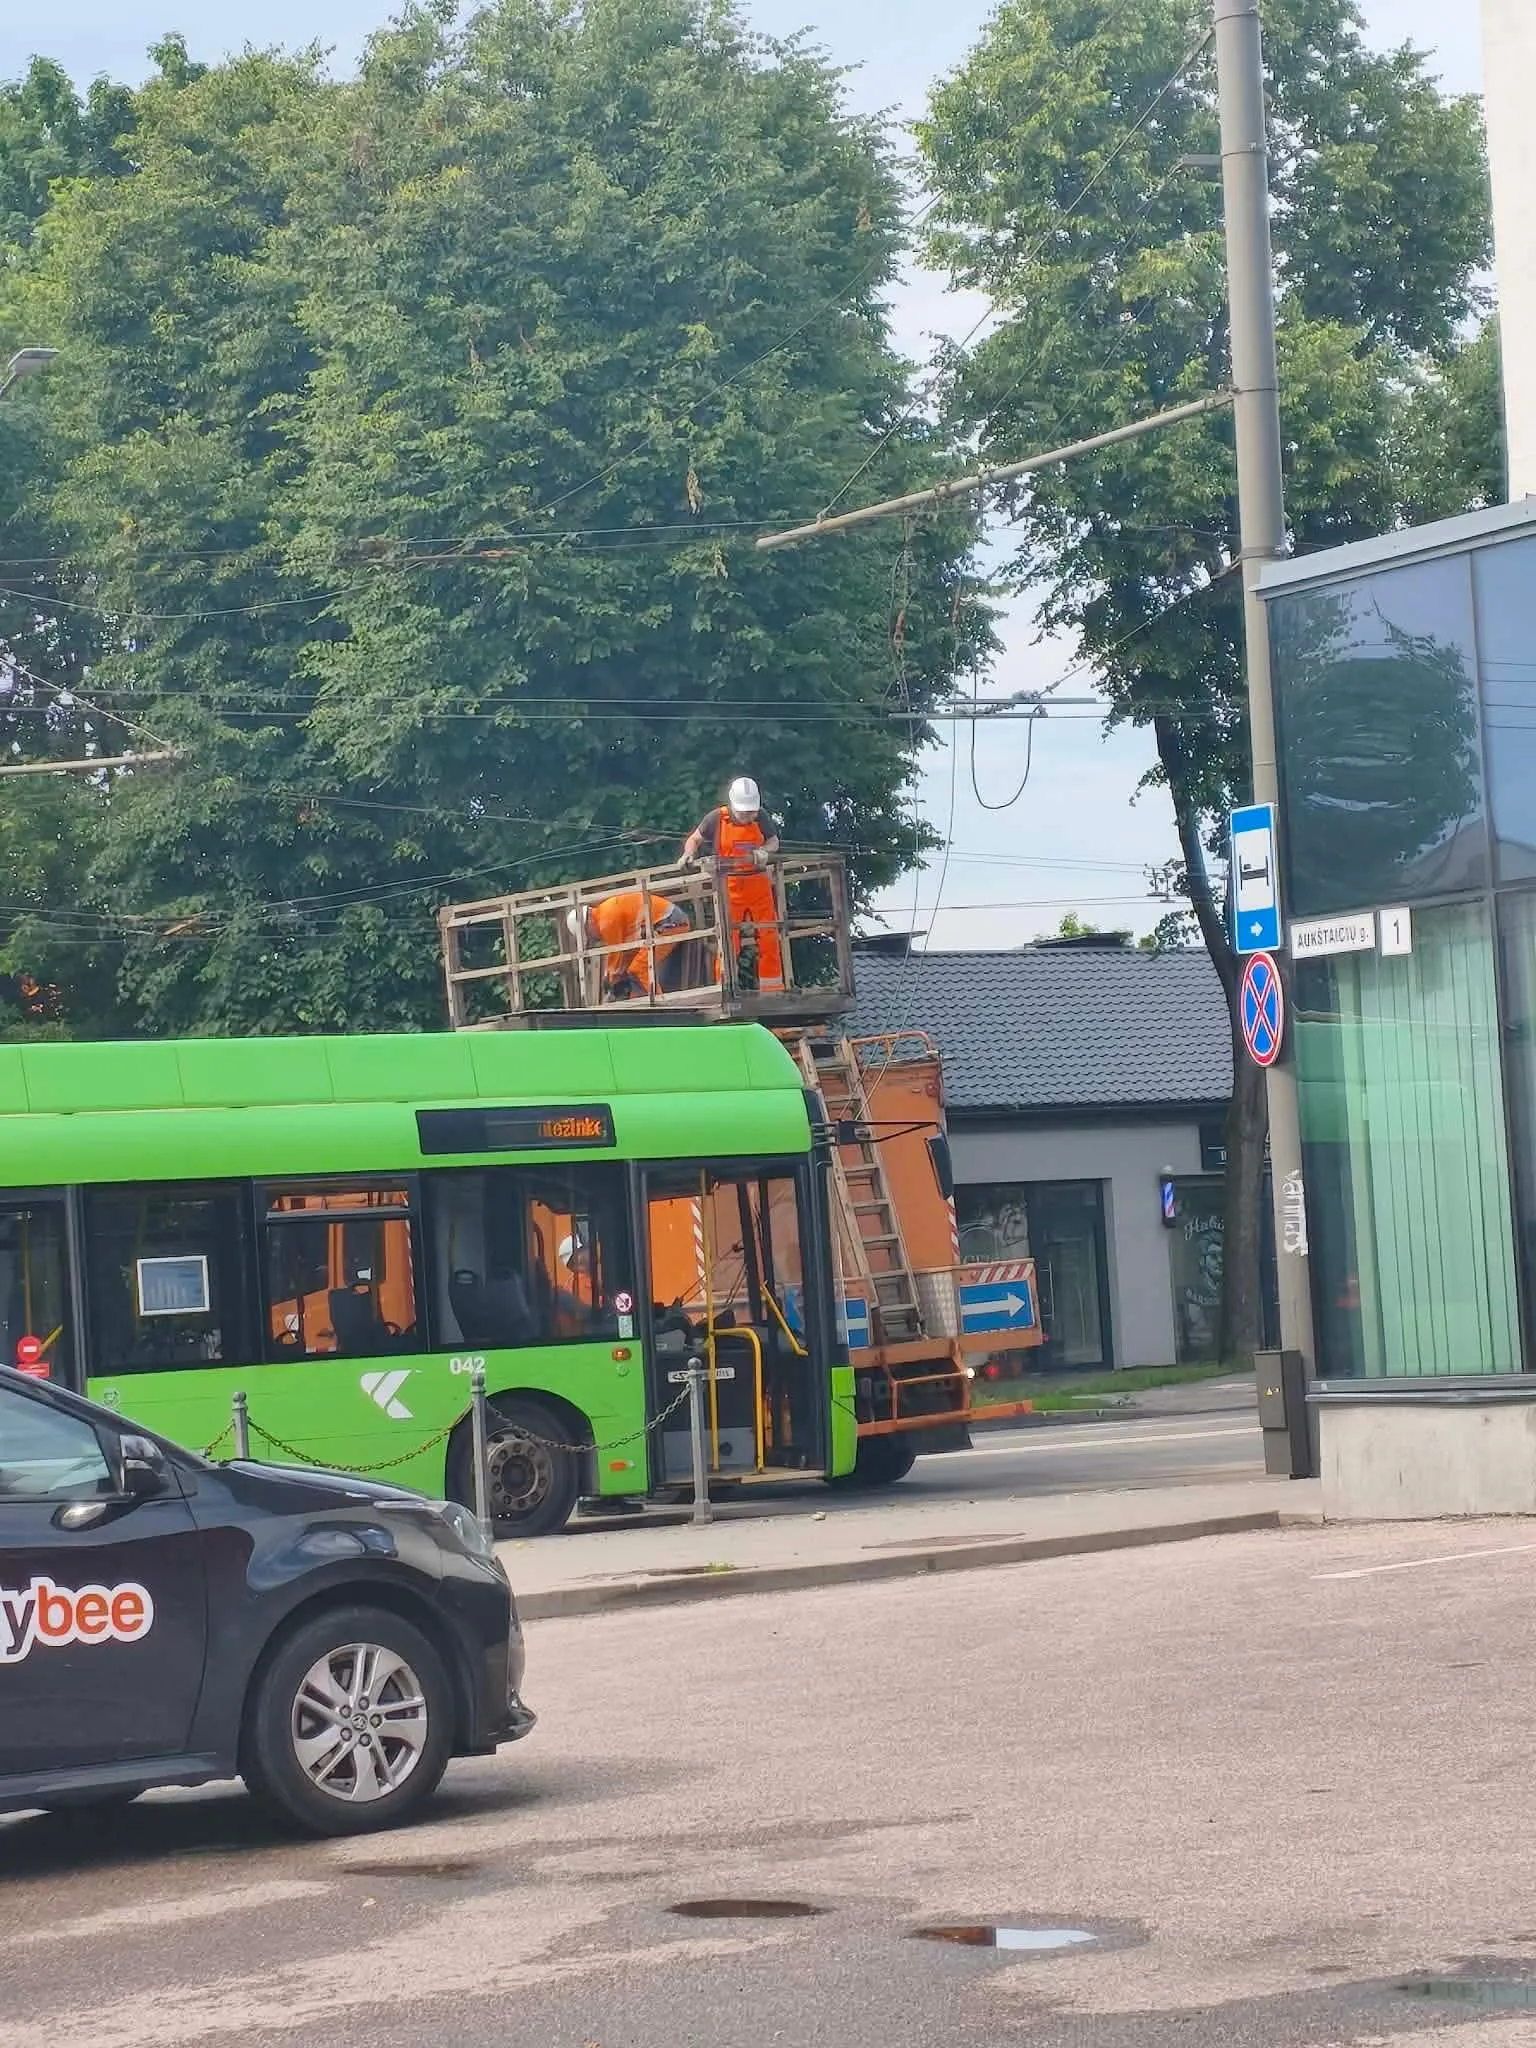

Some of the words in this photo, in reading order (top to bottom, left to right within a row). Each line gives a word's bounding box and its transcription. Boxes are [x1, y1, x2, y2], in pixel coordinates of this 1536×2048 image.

[1393, 919, 1400, 945] 1
[449, 1357, 485, 1375] 042
[2, 1585, 145, 1655] ybee
